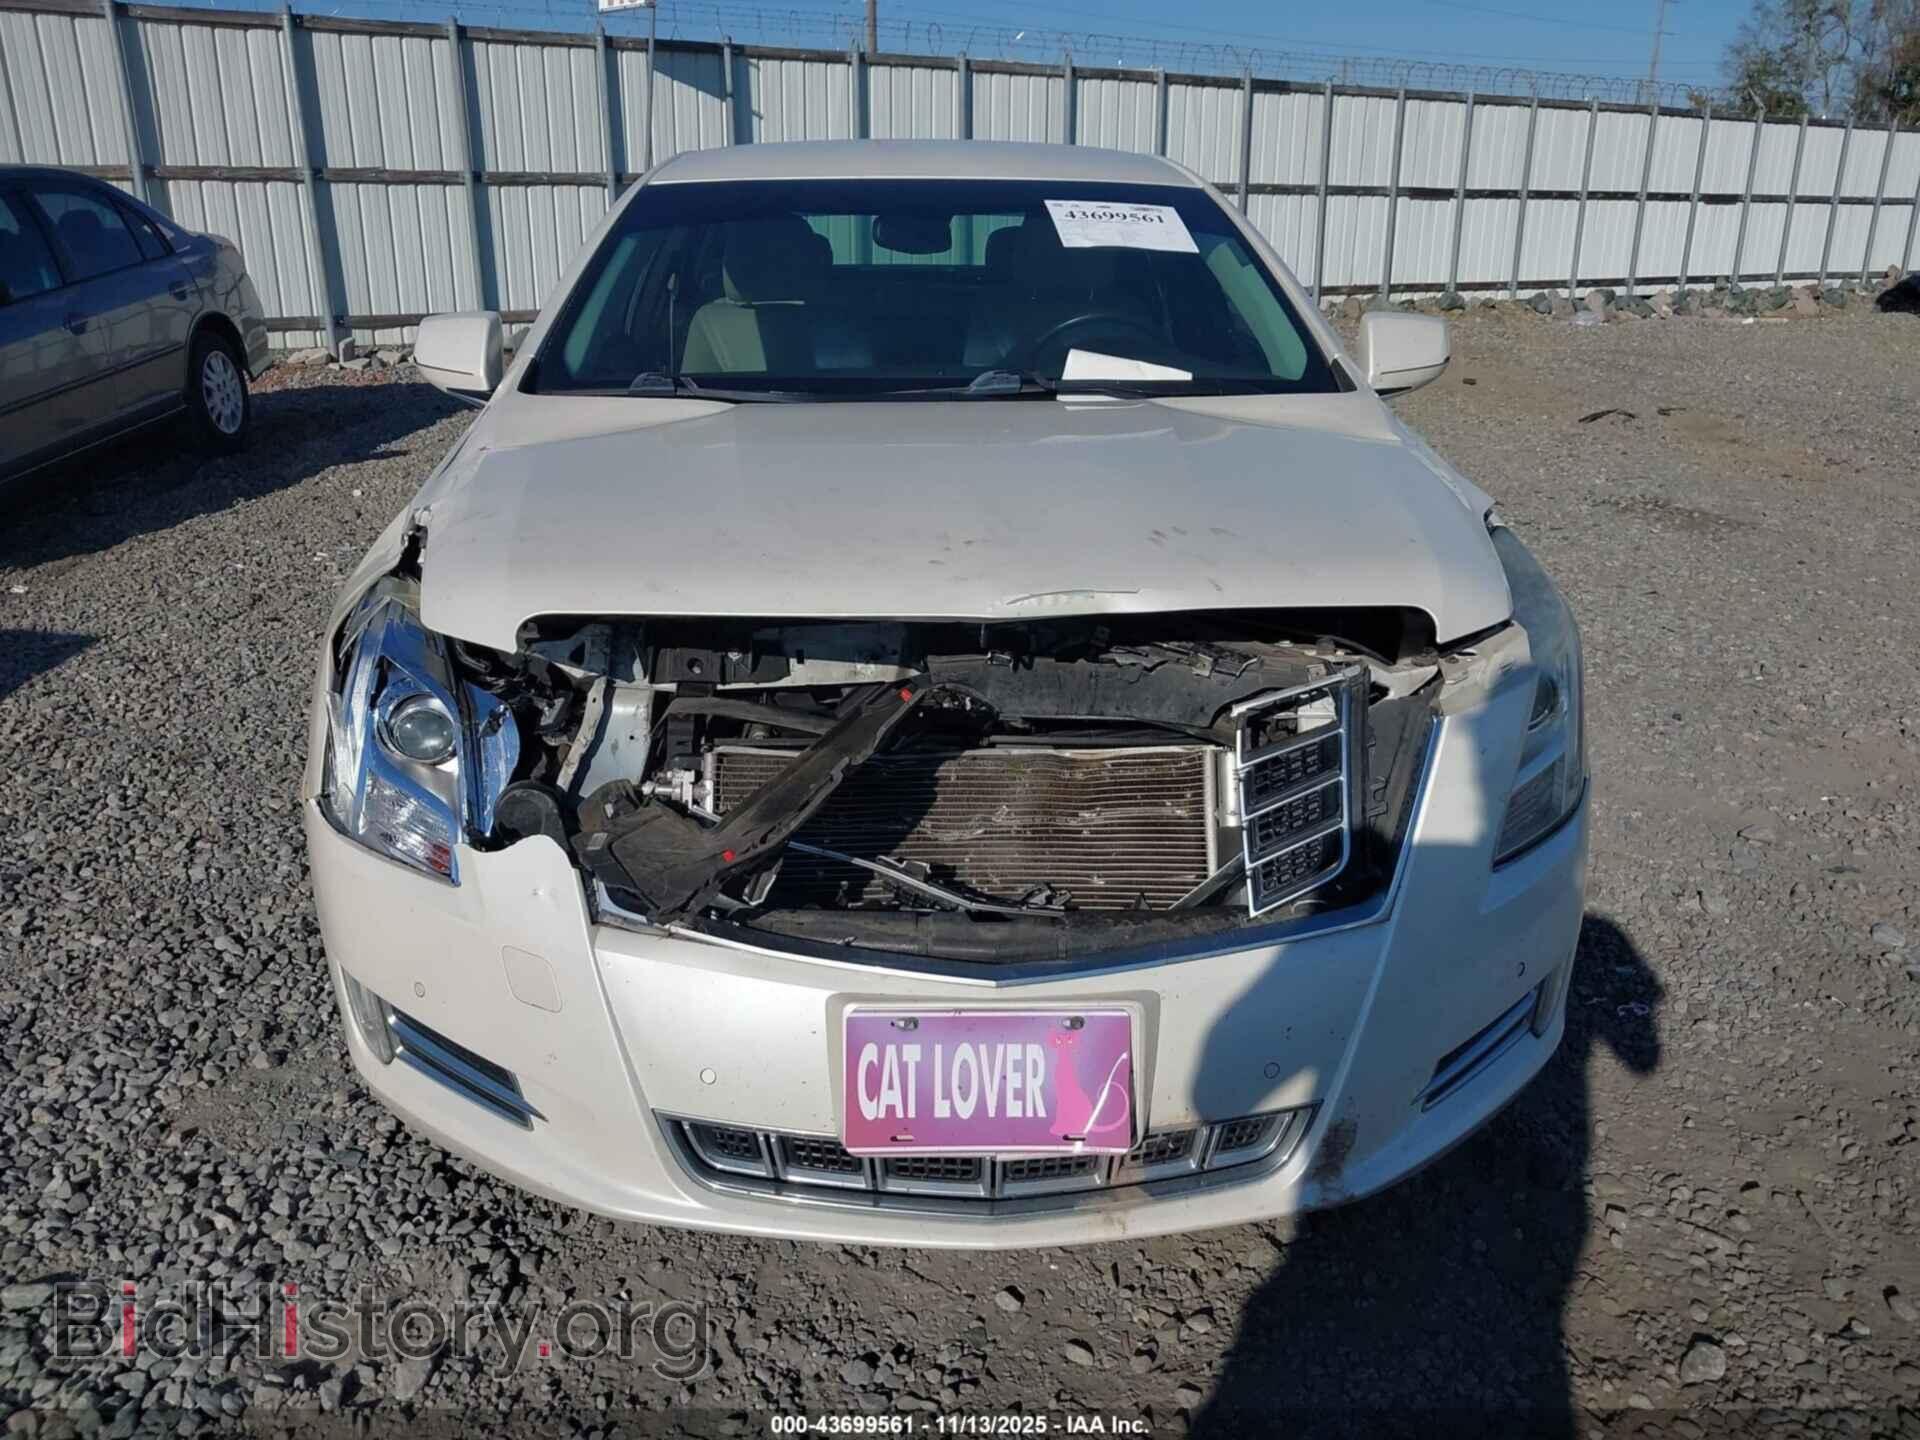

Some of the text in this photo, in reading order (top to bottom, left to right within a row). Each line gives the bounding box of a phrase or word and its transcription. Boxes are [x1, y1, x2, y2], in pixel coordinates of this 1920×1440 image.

[1064, 209, 1166, 224] 43699561
[857, 1042, 1047, 1121] CAT LOVER
